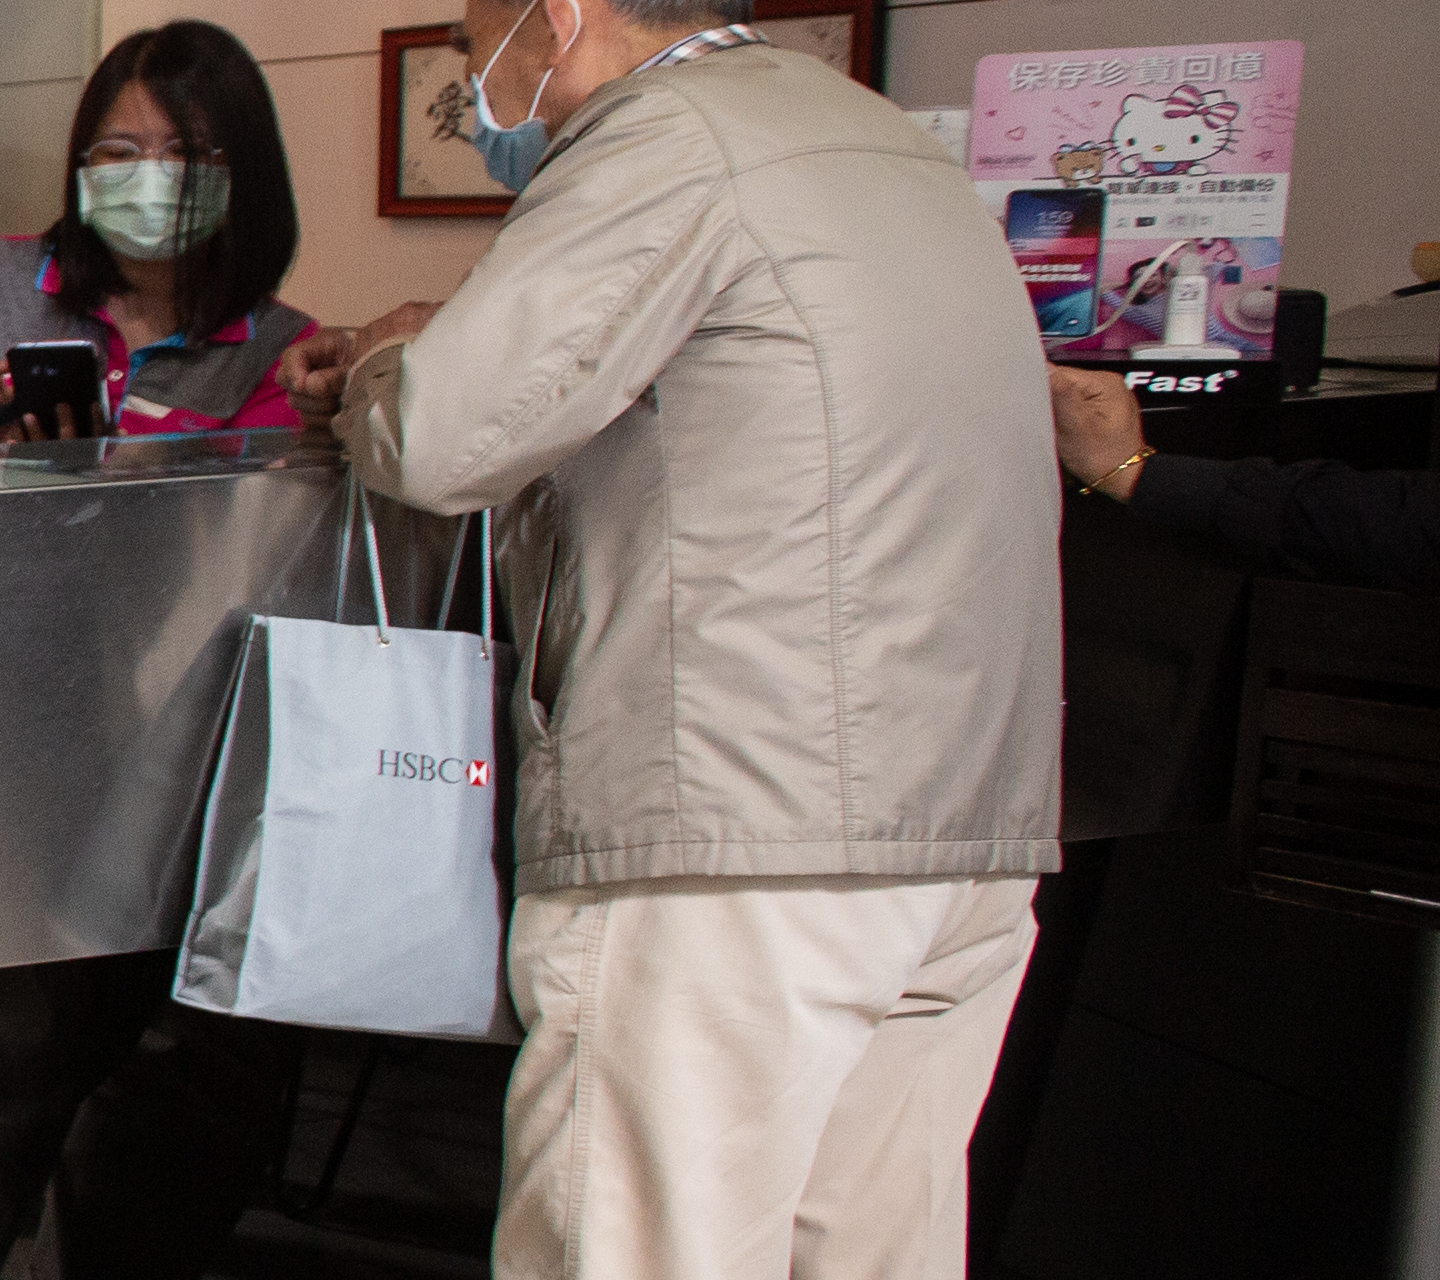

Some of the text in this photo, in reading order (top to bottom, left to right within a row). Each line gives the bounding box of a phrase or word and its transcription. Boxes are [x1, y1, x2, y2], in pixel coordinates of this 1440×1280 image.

[1006, 51, 1266, 91] 保存珍貴回憶
[377, 748, 465, 786] HSBC
